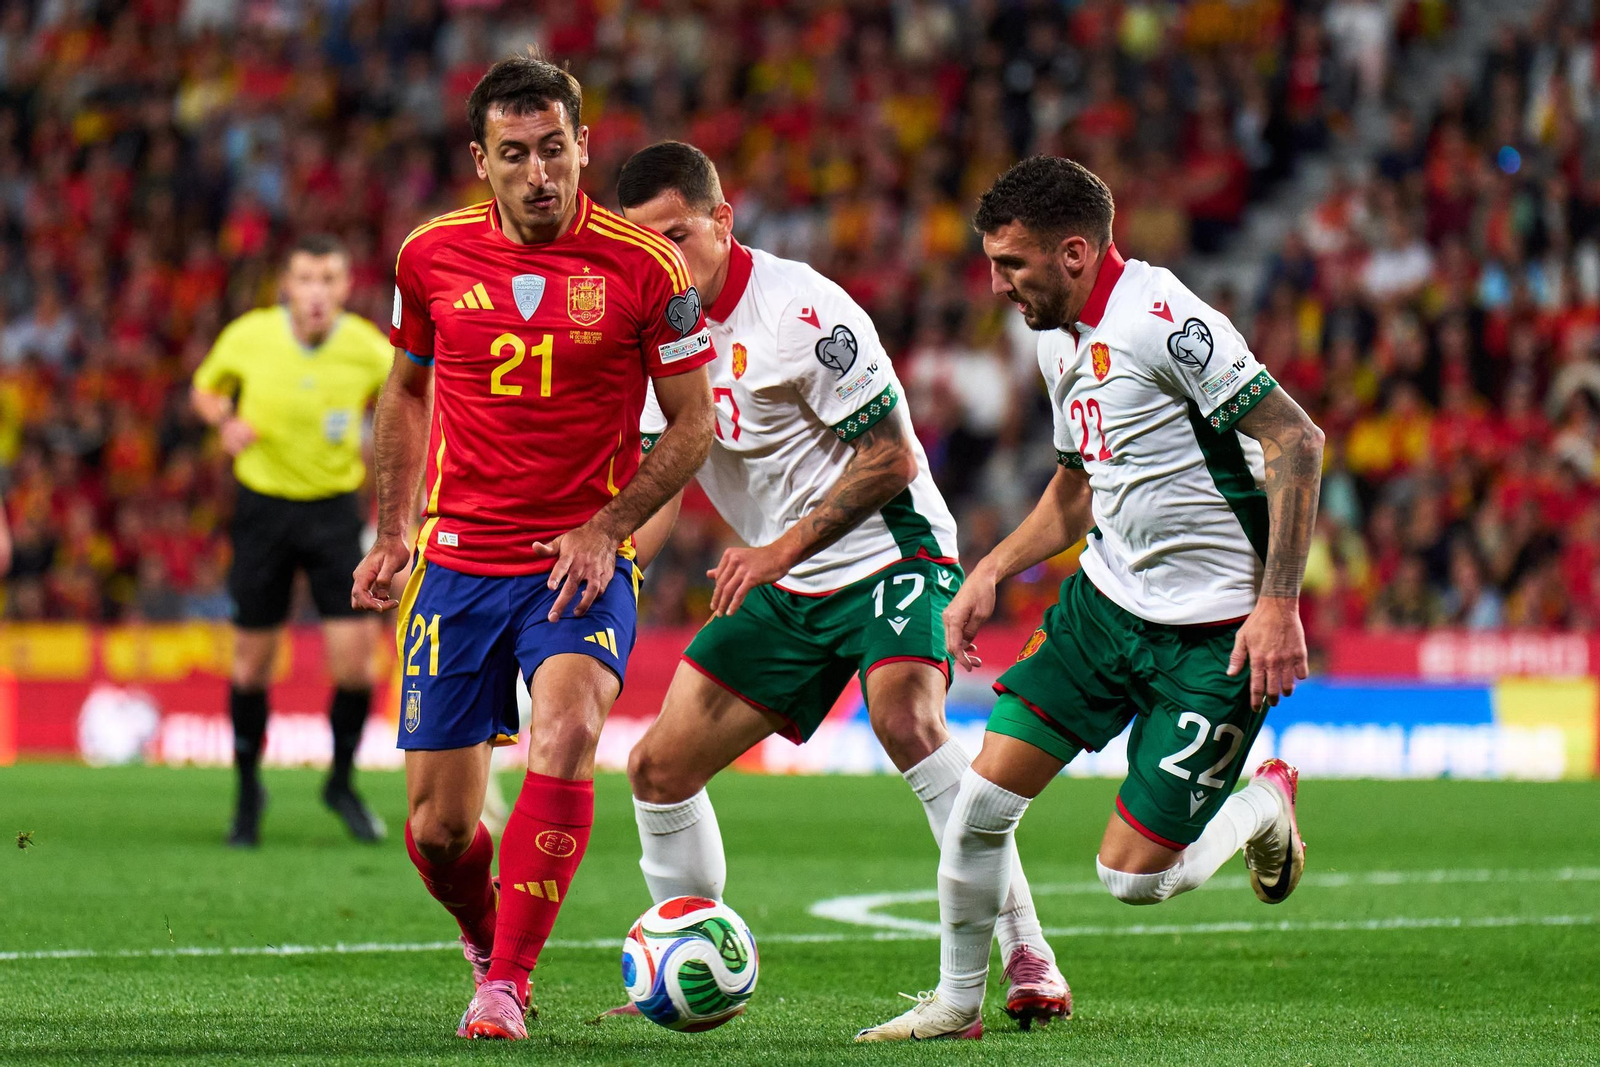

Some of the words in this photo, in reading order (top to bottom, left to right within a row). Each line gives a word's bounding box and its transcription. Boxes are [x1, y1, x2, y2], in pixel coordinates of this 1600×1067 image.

[490, 332, 554, 397] 21
[661, 342, 697, 357] FOUNDATION
[1070, 398, 1113, 462] 22
[872, 573, 925, 618] 17
[406, 614, 442, 676] 21
[1158, 711, 1245, 789] 22
